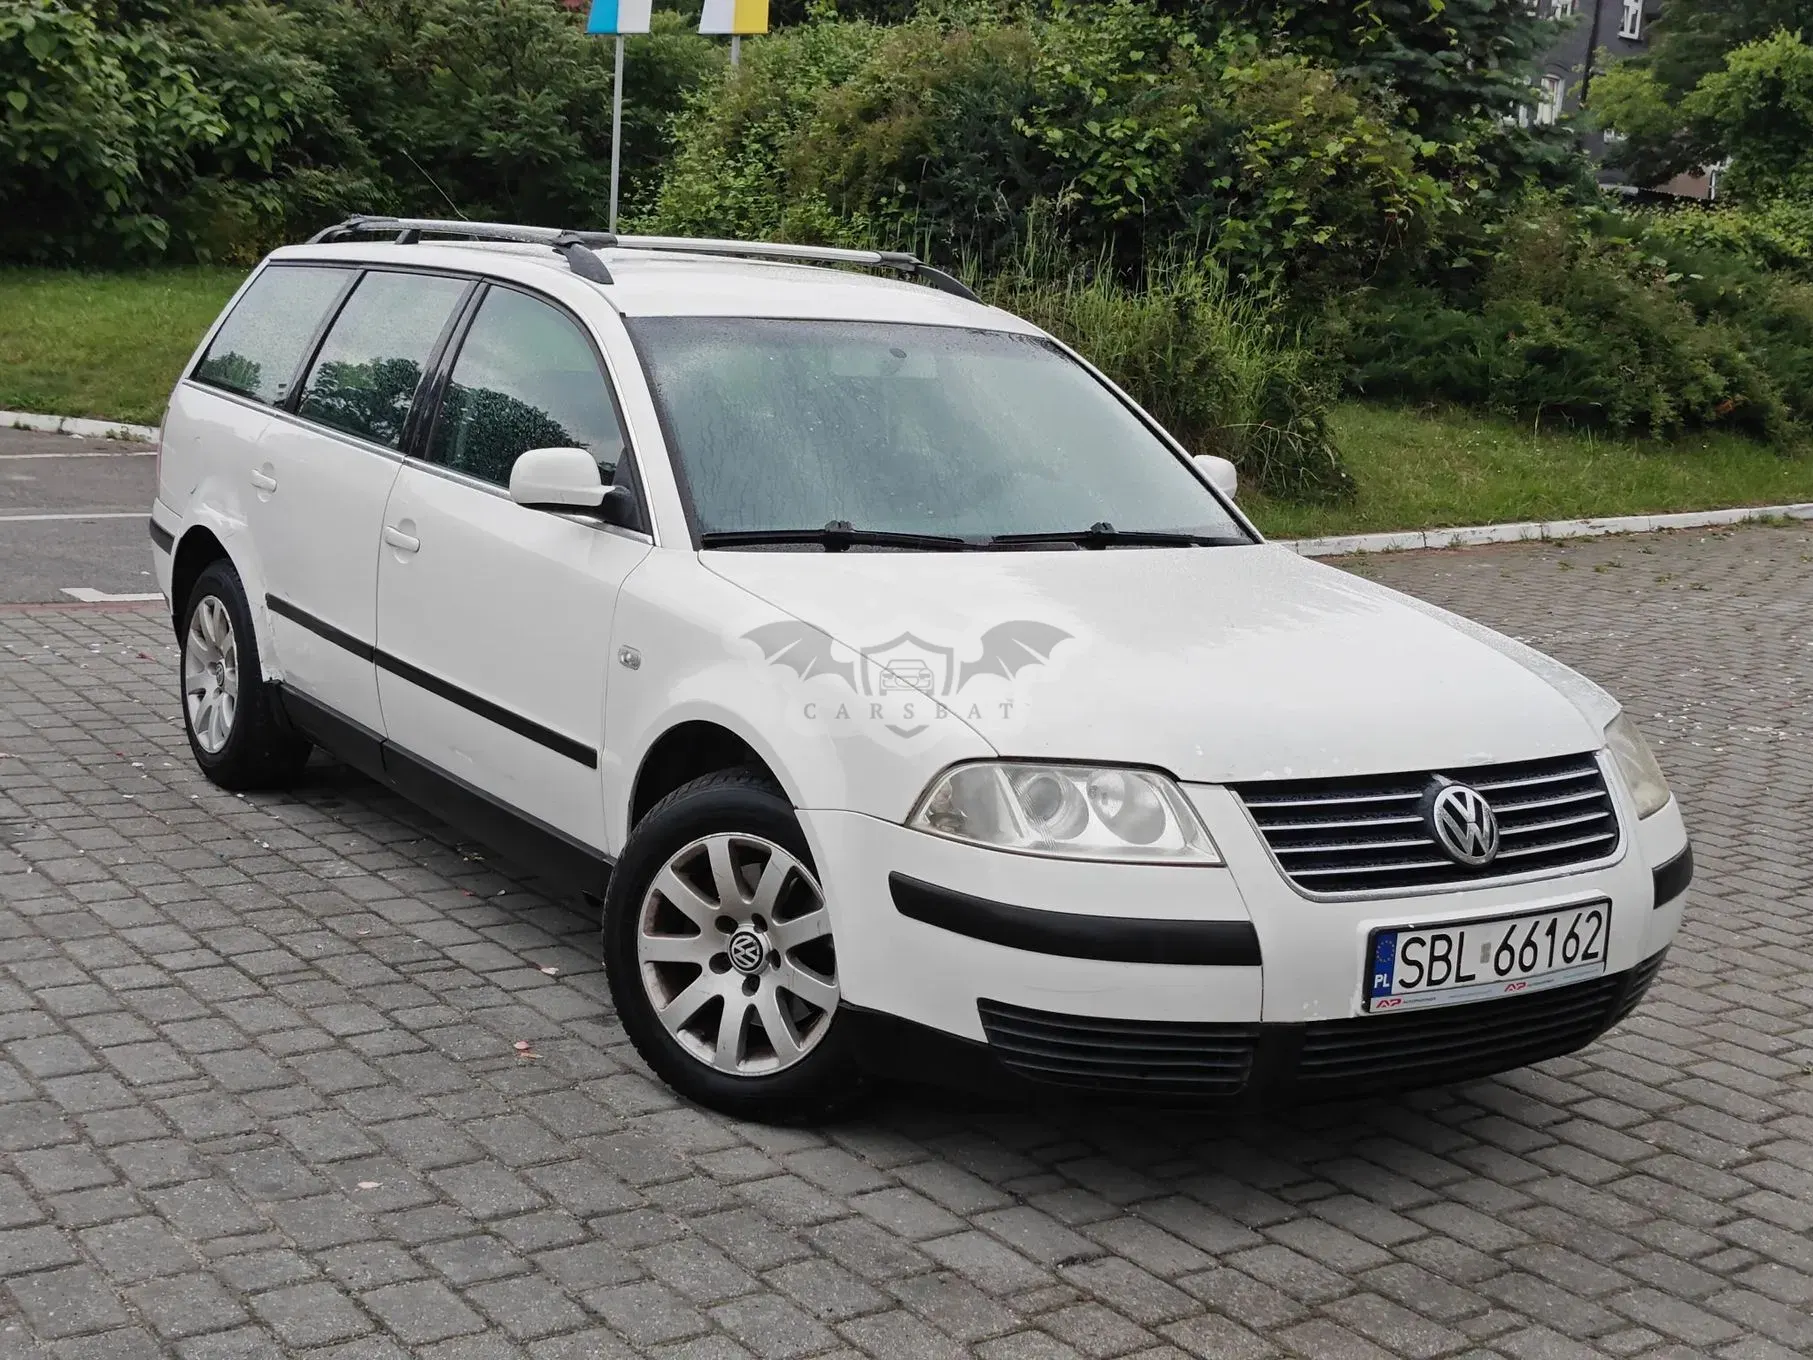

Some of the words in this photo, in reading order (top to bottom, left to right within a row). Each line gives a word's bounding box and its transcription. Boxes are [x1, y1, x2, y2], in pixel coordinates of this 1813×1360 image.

[1398, 931, 1476, 988] SBL
[1493, 910, 1602, 976] 66162
[1373, 973, 1390, 989] PL
[1376, 998, 1402, 1009] AP
